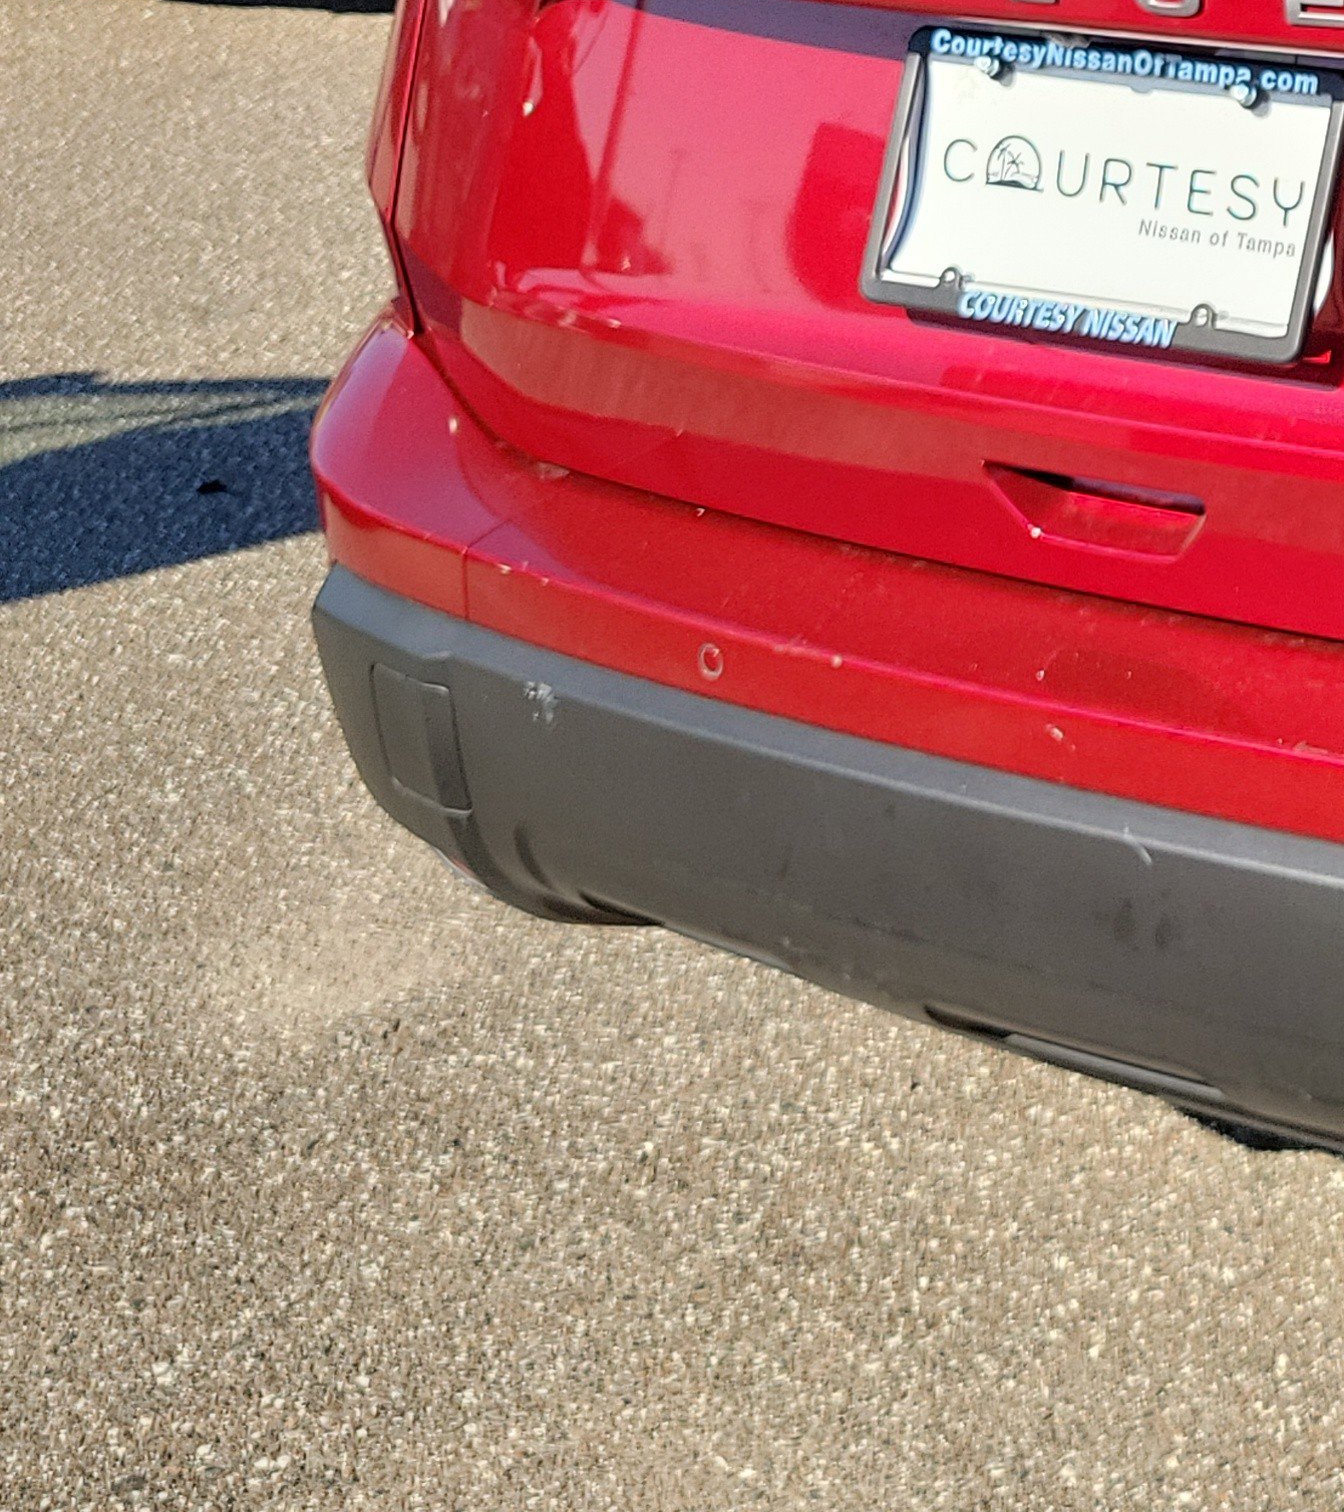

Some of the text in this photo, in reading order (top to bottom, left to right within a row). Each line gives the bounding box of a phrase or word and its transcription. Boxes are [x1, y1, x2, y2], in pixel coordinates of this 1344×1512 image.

[943, 134, 1305, 227] COURTESY
[1138, 219, 1297, 260] Nissan of Tampa
[958, 291, 1179, 349] COURTESY NISSAN
